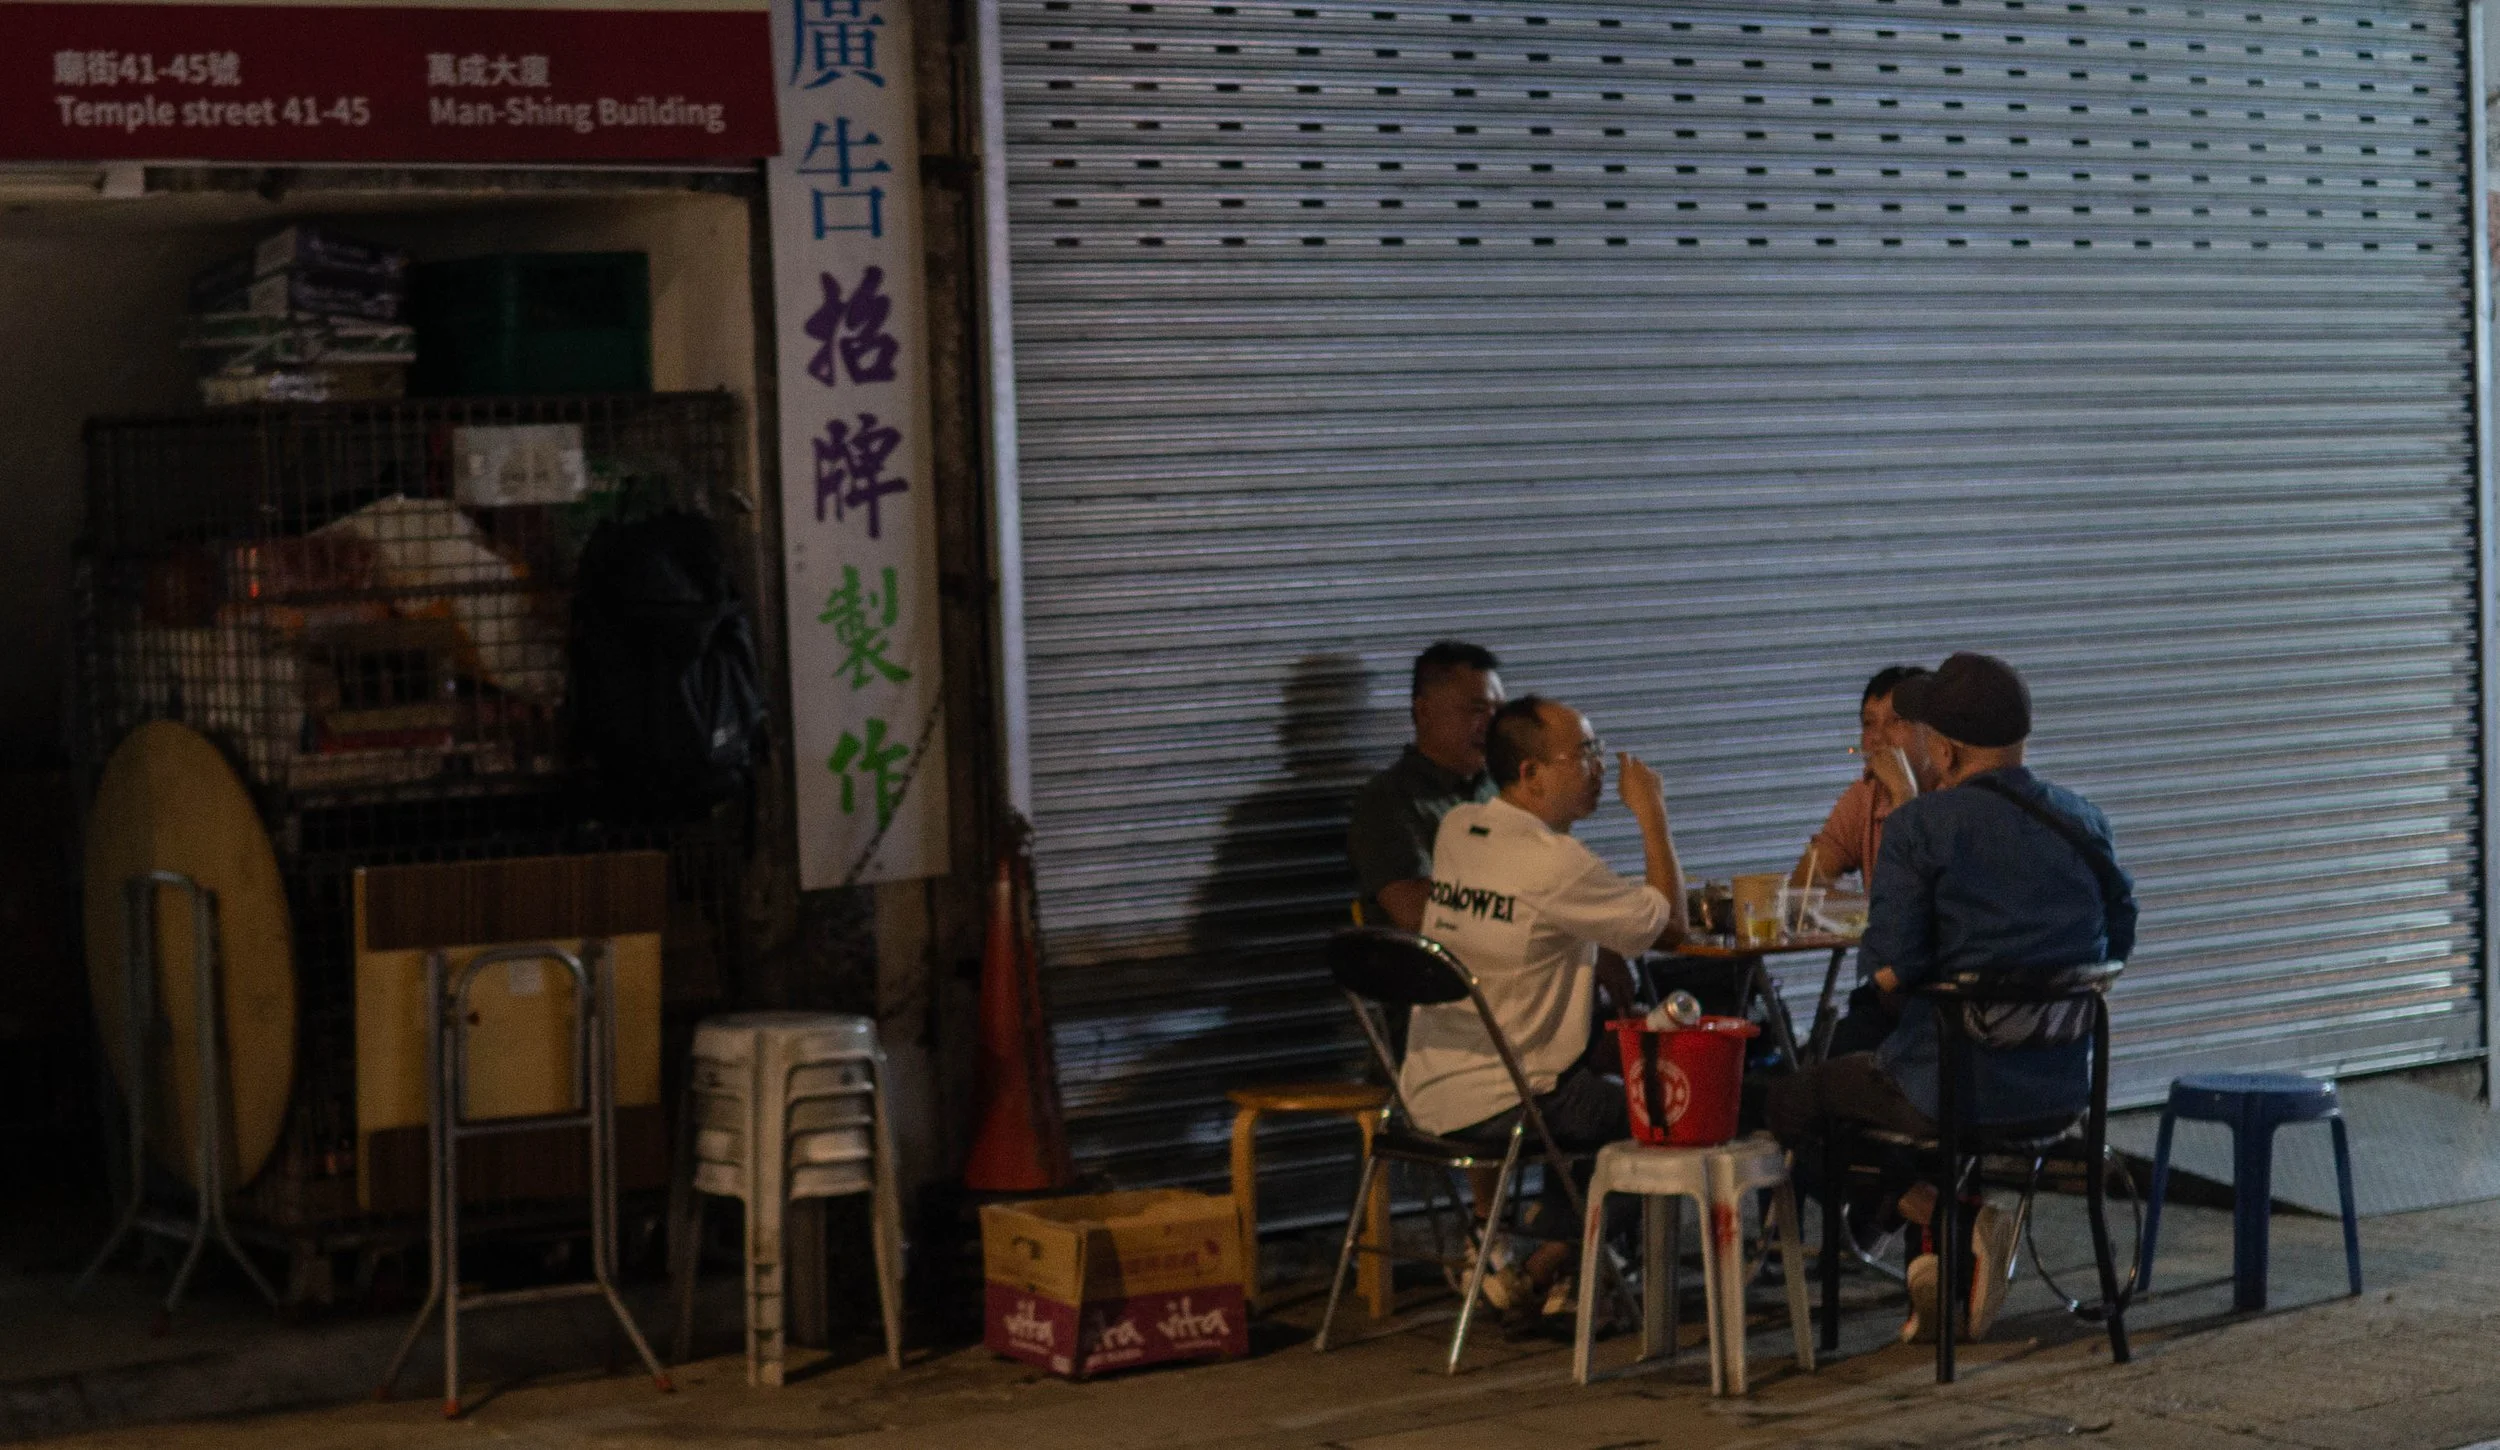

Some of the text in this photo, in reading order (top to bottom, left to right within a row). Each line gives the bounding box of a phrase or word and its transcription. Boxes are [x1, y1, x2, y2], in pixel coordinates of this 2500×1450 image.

[55, 95, 370, 133] Temple street 41-45
[428, 96, 727, 134] Man-Shing Building
[788, 0, 912, 830] 廣告招牌製作
[1156, 1295, 1231, 1340] vita
